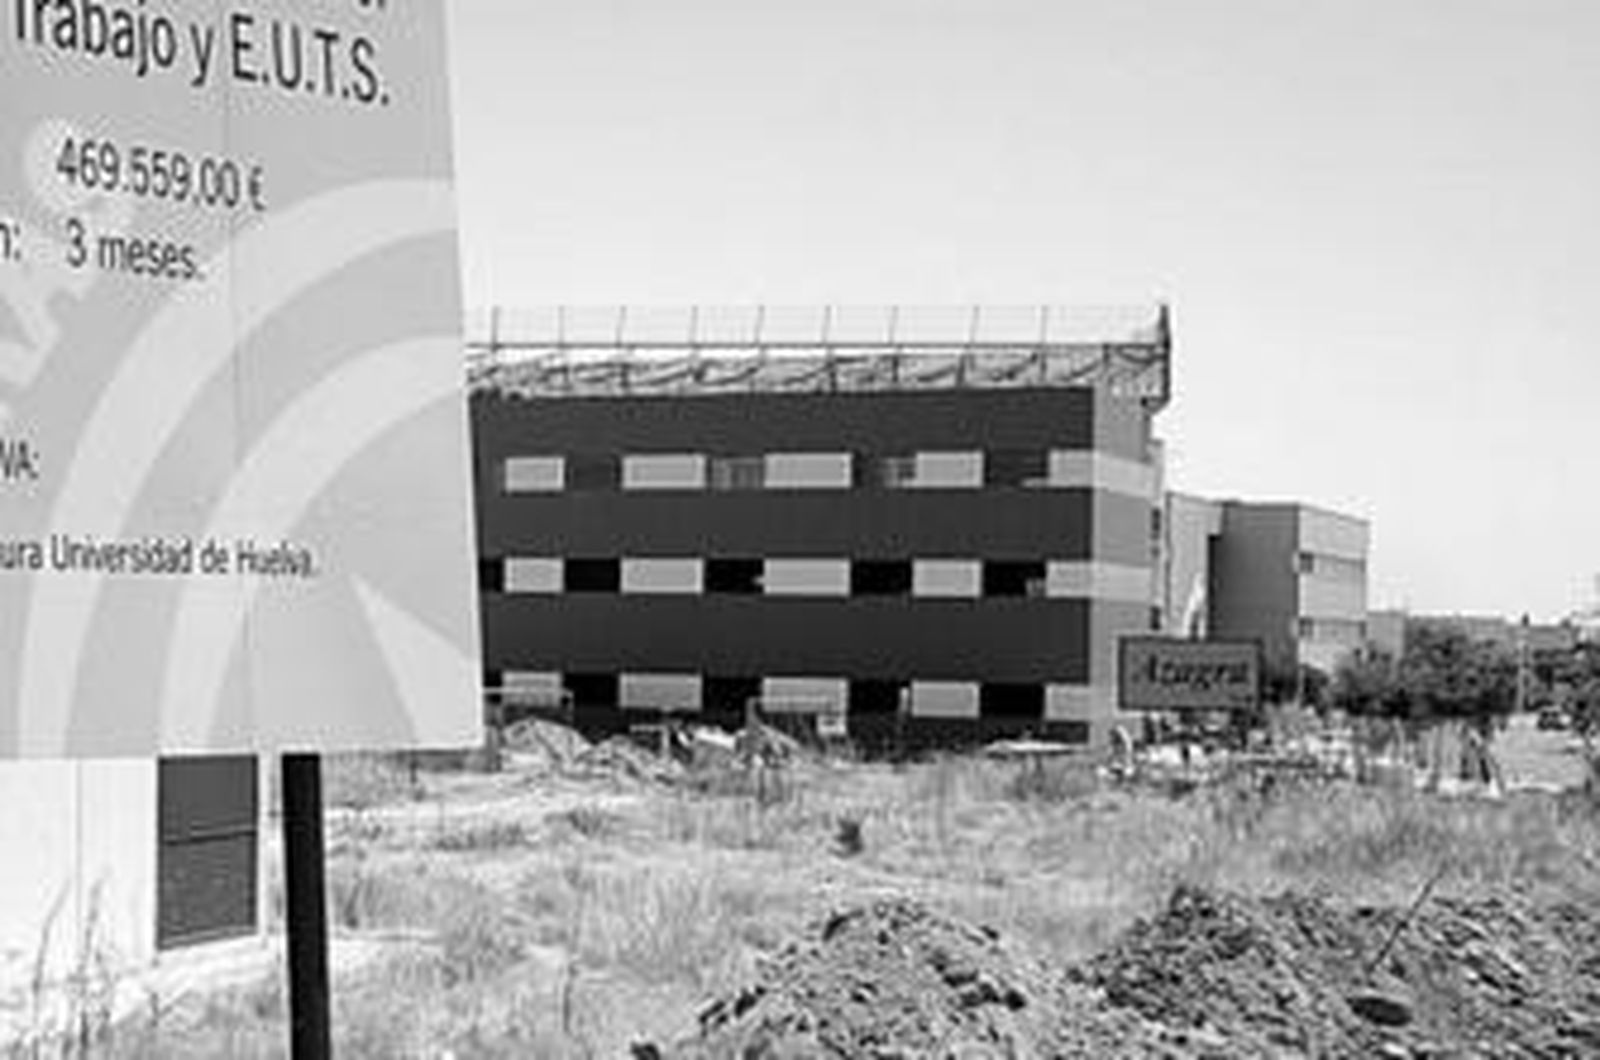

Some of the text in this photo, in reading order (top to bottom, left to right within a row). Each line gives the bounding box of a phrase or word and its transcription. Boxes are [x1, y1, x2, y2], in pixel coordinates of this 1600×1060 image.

[189, 23, 214, 87] y
[230, 13, 390, 105] E.U.T.S.
[250, 165, 266, 211] €
[66, 217, 87, 268] 3
[98, 236, 206, 281] meses.
[51, 533, 193, 575] Universidad
[200, 537, 231, 575] de
